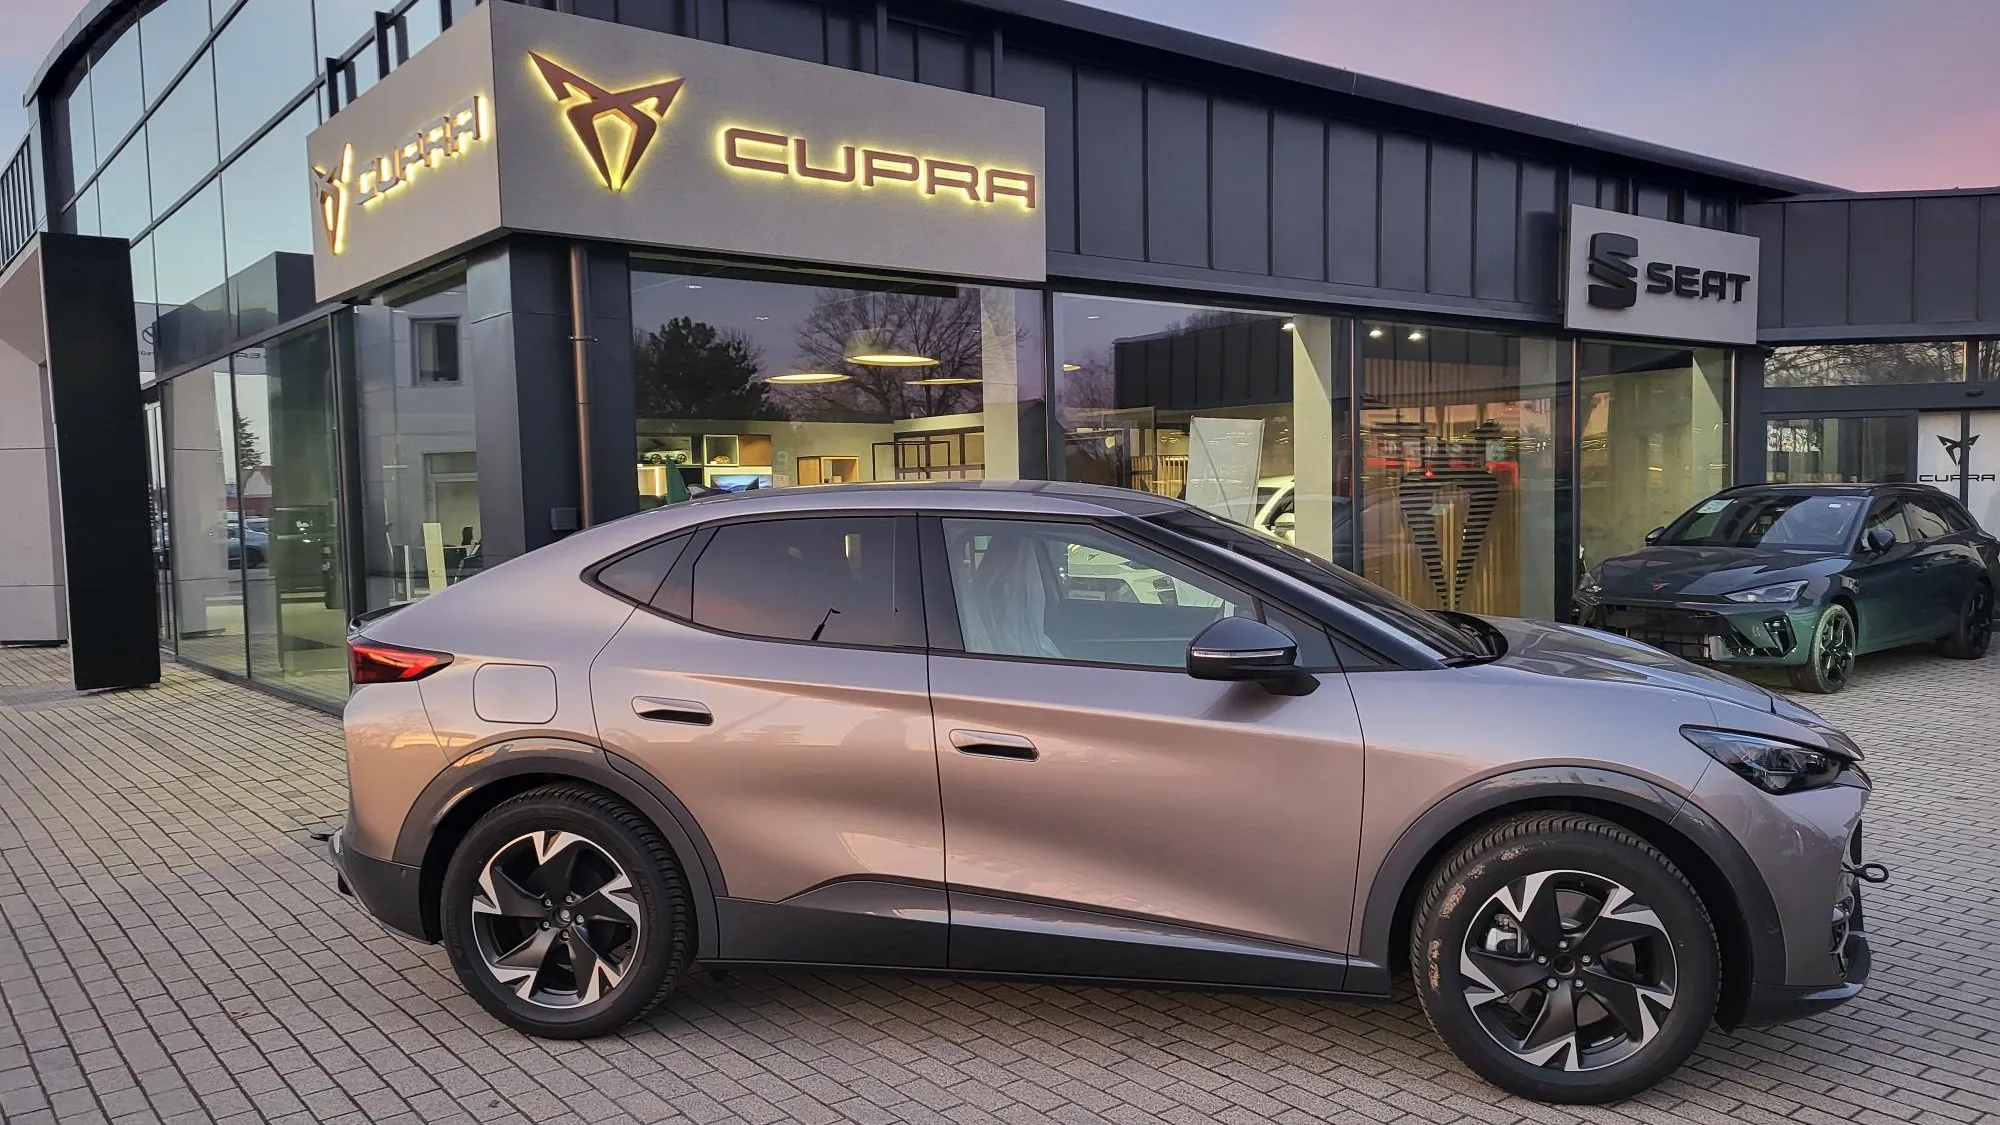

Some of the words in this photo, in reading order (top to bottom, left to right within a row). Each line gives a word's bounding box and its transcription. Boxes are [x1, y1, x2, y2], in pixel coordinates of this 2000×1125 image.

[357, 95, 482, 206] CUPRA
[724, 127, 1036, 209] CUPRA
[1646, 261, 1751, 303] SEAT
